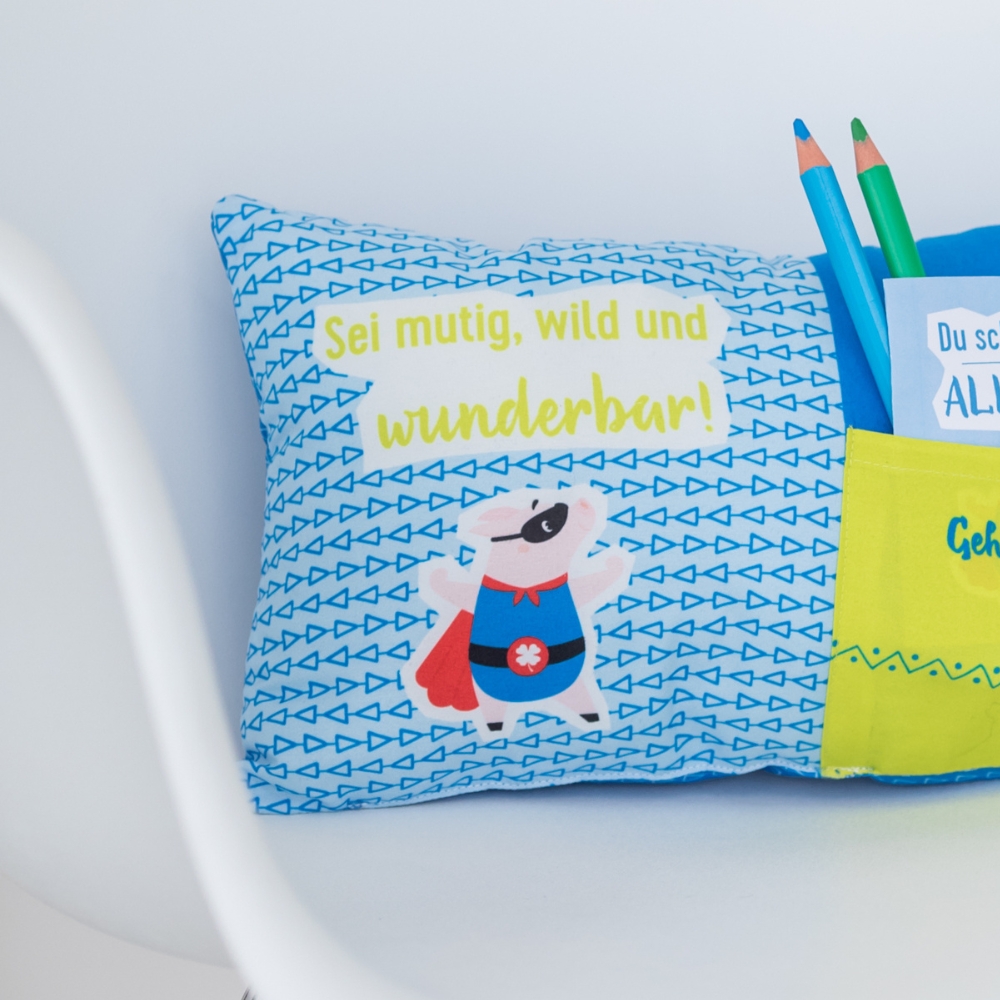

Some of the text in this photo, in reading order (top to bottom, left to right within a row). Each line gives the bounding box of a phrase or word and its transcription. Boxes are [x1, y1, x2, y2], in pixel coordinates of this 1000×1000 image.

[325, 300, 709, 360] Sei mutig, wild und
[938, 321, 967, 352] Du
[377, 372, 714, 450] wunderbar!
